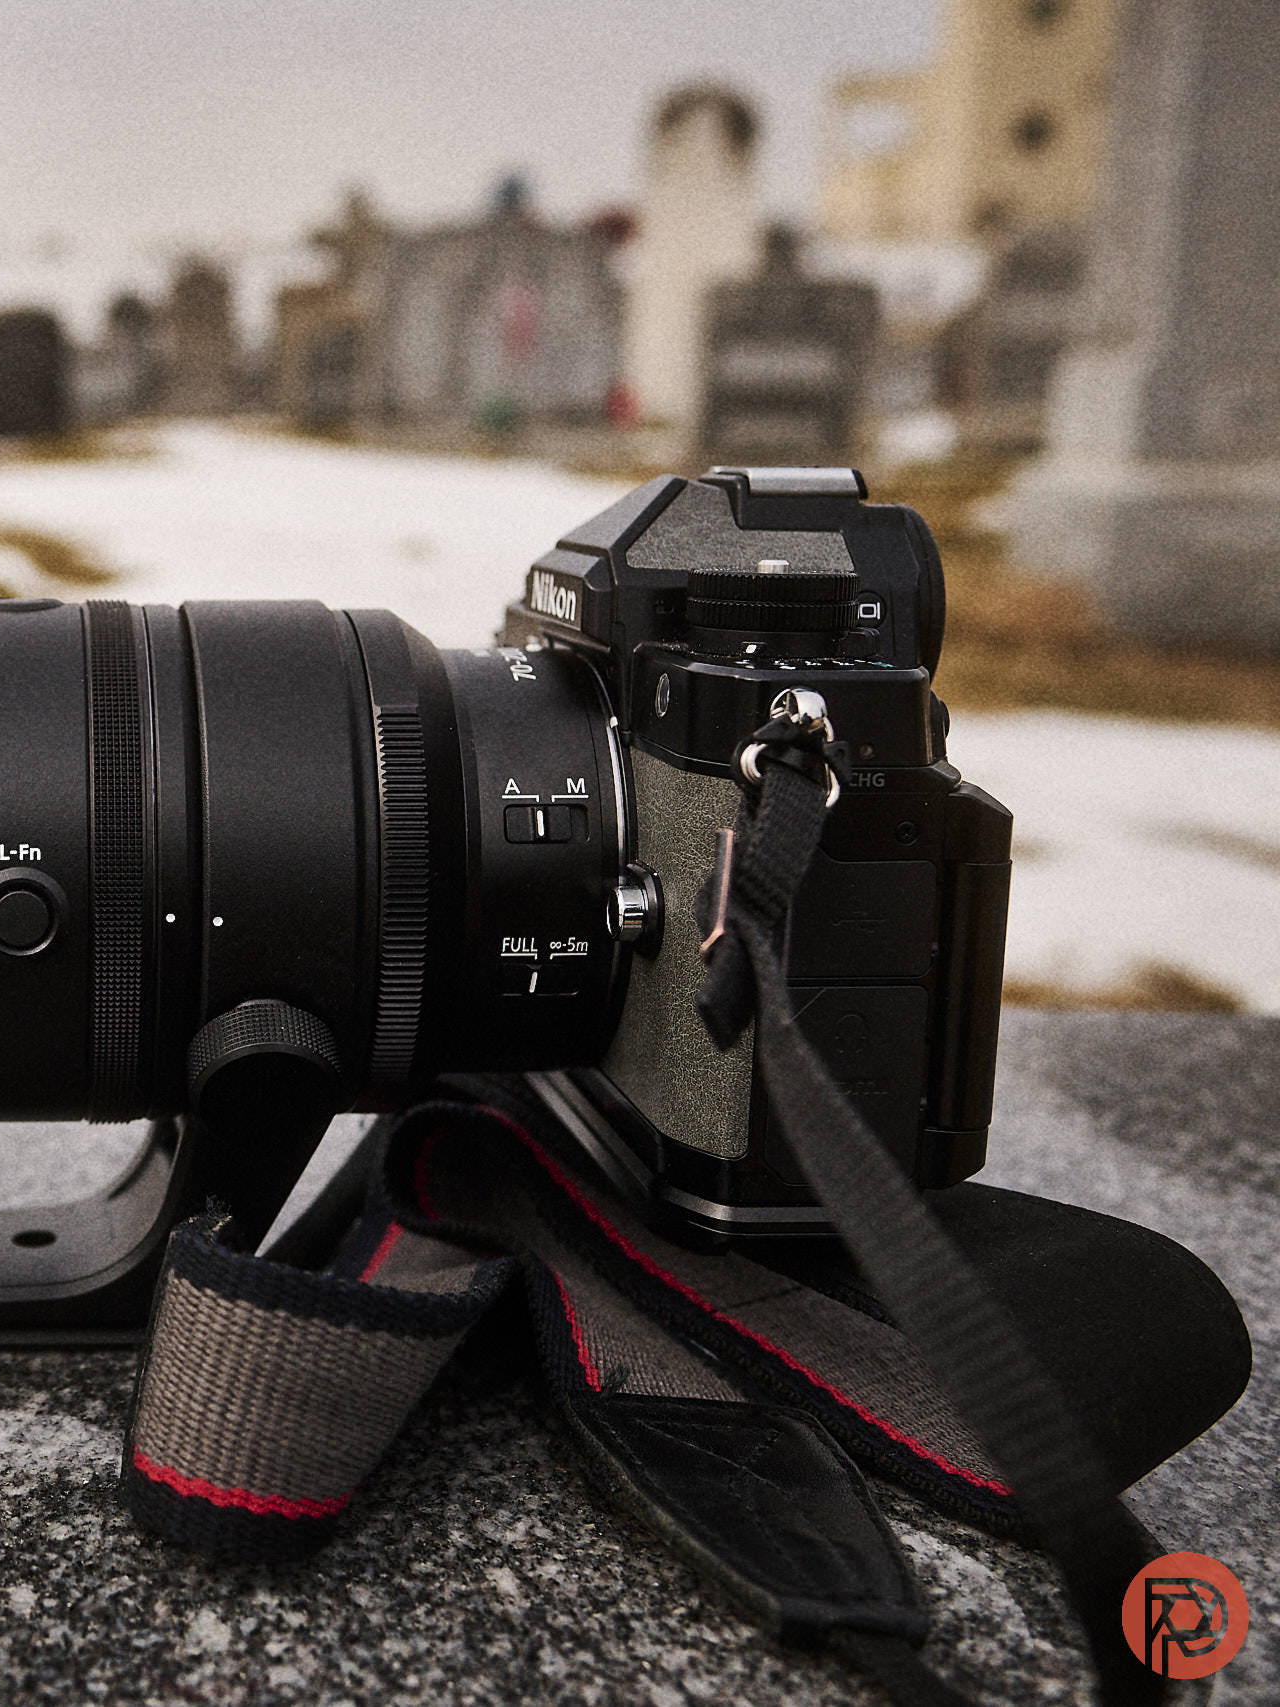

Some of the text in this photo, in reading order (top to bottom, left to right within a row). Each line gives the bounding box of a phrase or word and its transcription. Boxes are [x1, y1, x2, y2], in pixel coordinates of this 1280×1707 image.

[530, 570, 577, 621] Nikon
[504, 777, 586, 794] A M
[0, 843, 42, 861] L-Fn
[502, 937, 539, 952] FULL
